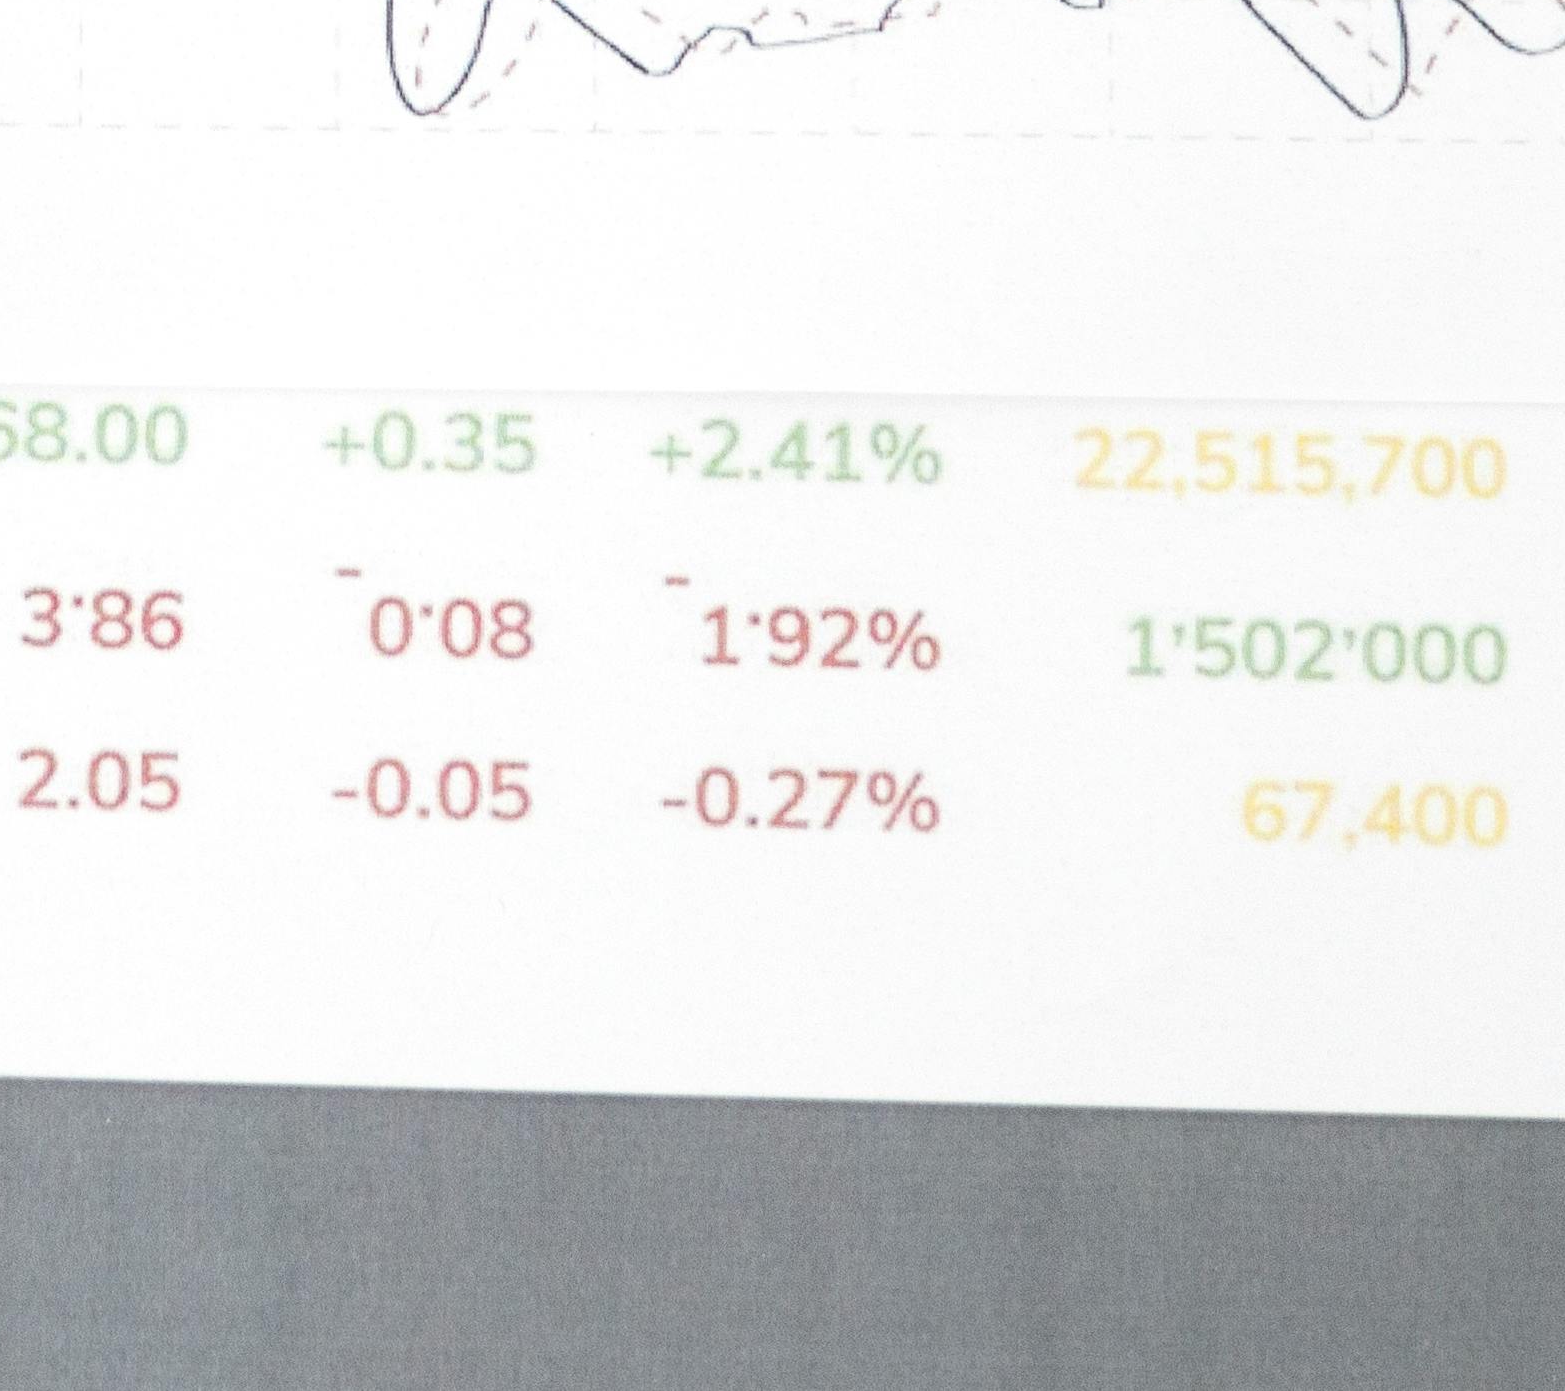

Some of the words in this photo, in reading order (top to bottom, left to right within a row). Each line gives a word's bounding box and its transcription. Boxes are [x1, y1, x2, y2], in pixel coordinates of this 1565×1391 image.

[327, 412, 534, 473] +0.35
[652, 419, 942, 484] +2.41%
[1078, 428, 1506, 501] 22,515,700
[20, 748, 180, 812] 2.05
[333, 758, 531, 821] -0.05
[662, 766, 940, 833] -0.27%
[1244, 781, 1507, 847] 67,400
